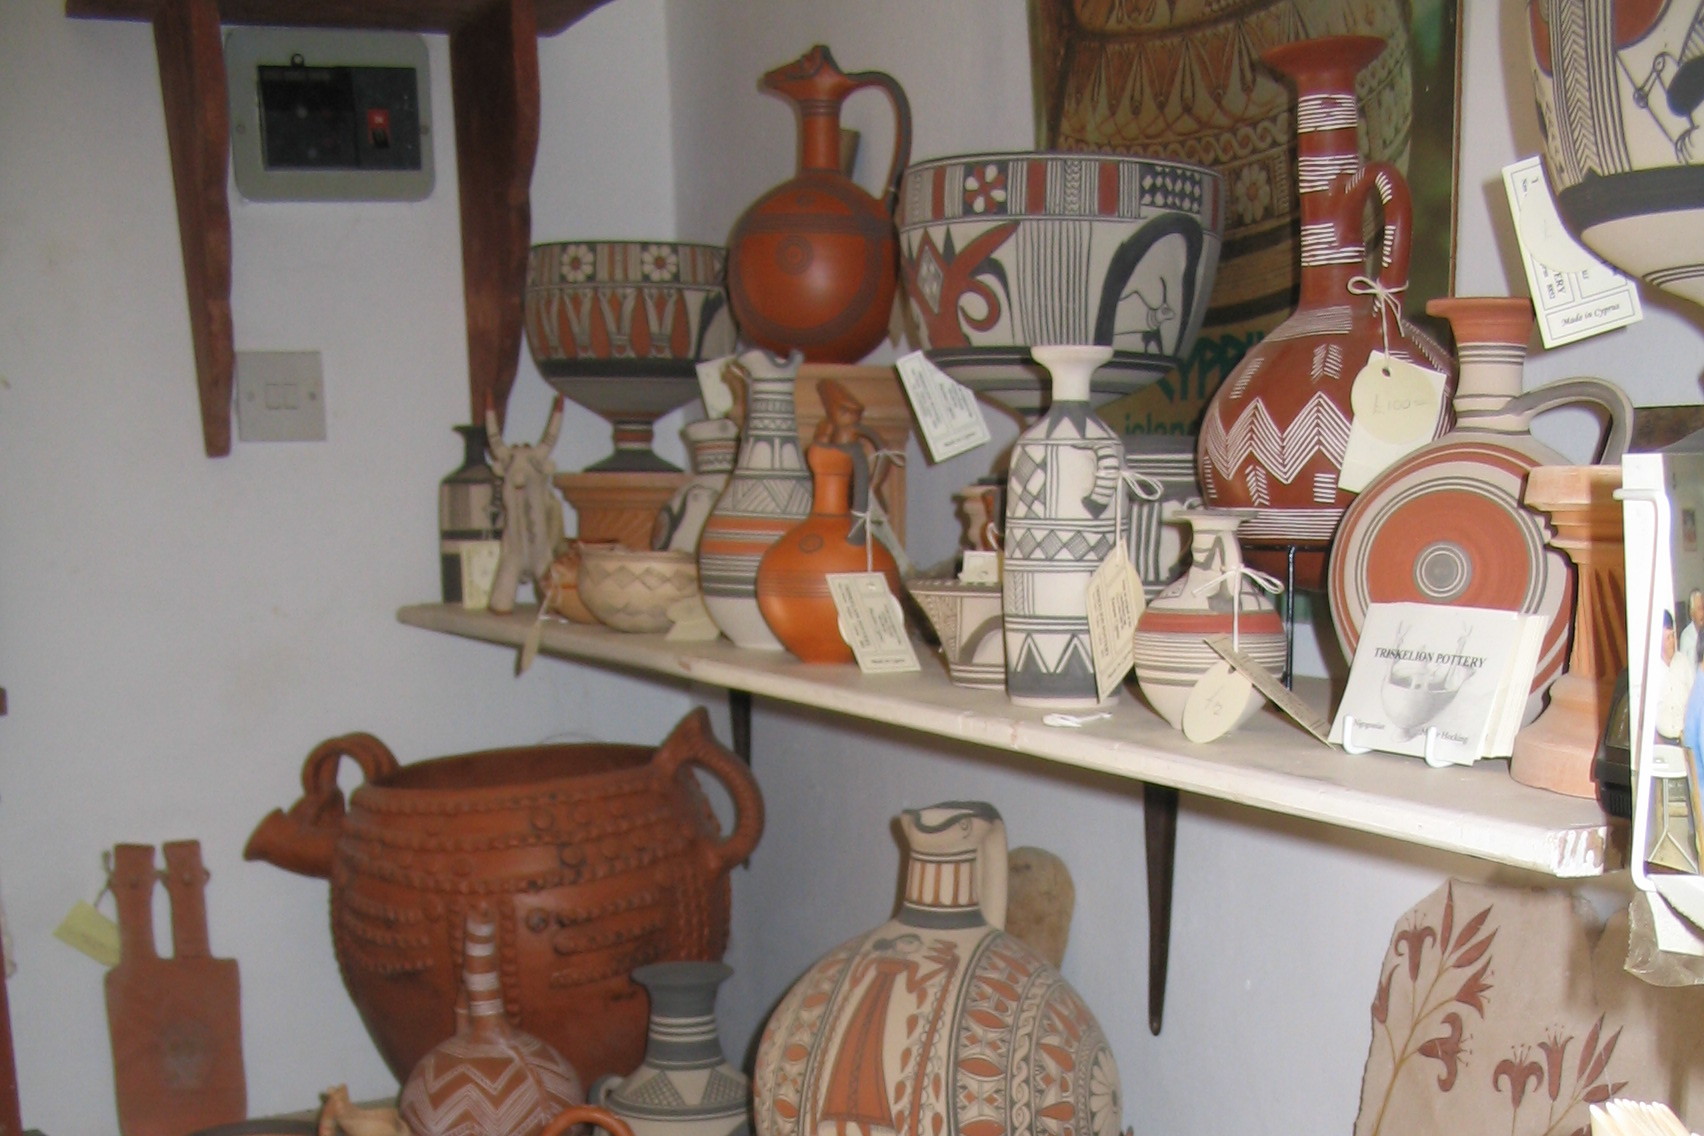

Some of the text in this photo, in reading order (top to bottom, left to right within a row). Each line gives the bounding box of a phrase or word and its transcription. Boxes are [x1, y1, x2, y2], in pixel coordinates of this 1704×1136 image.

[1561, 302, 1620, 327] Made in Cyprus
[1374, 647, 1487, 669] TRISKELION POTTERY
